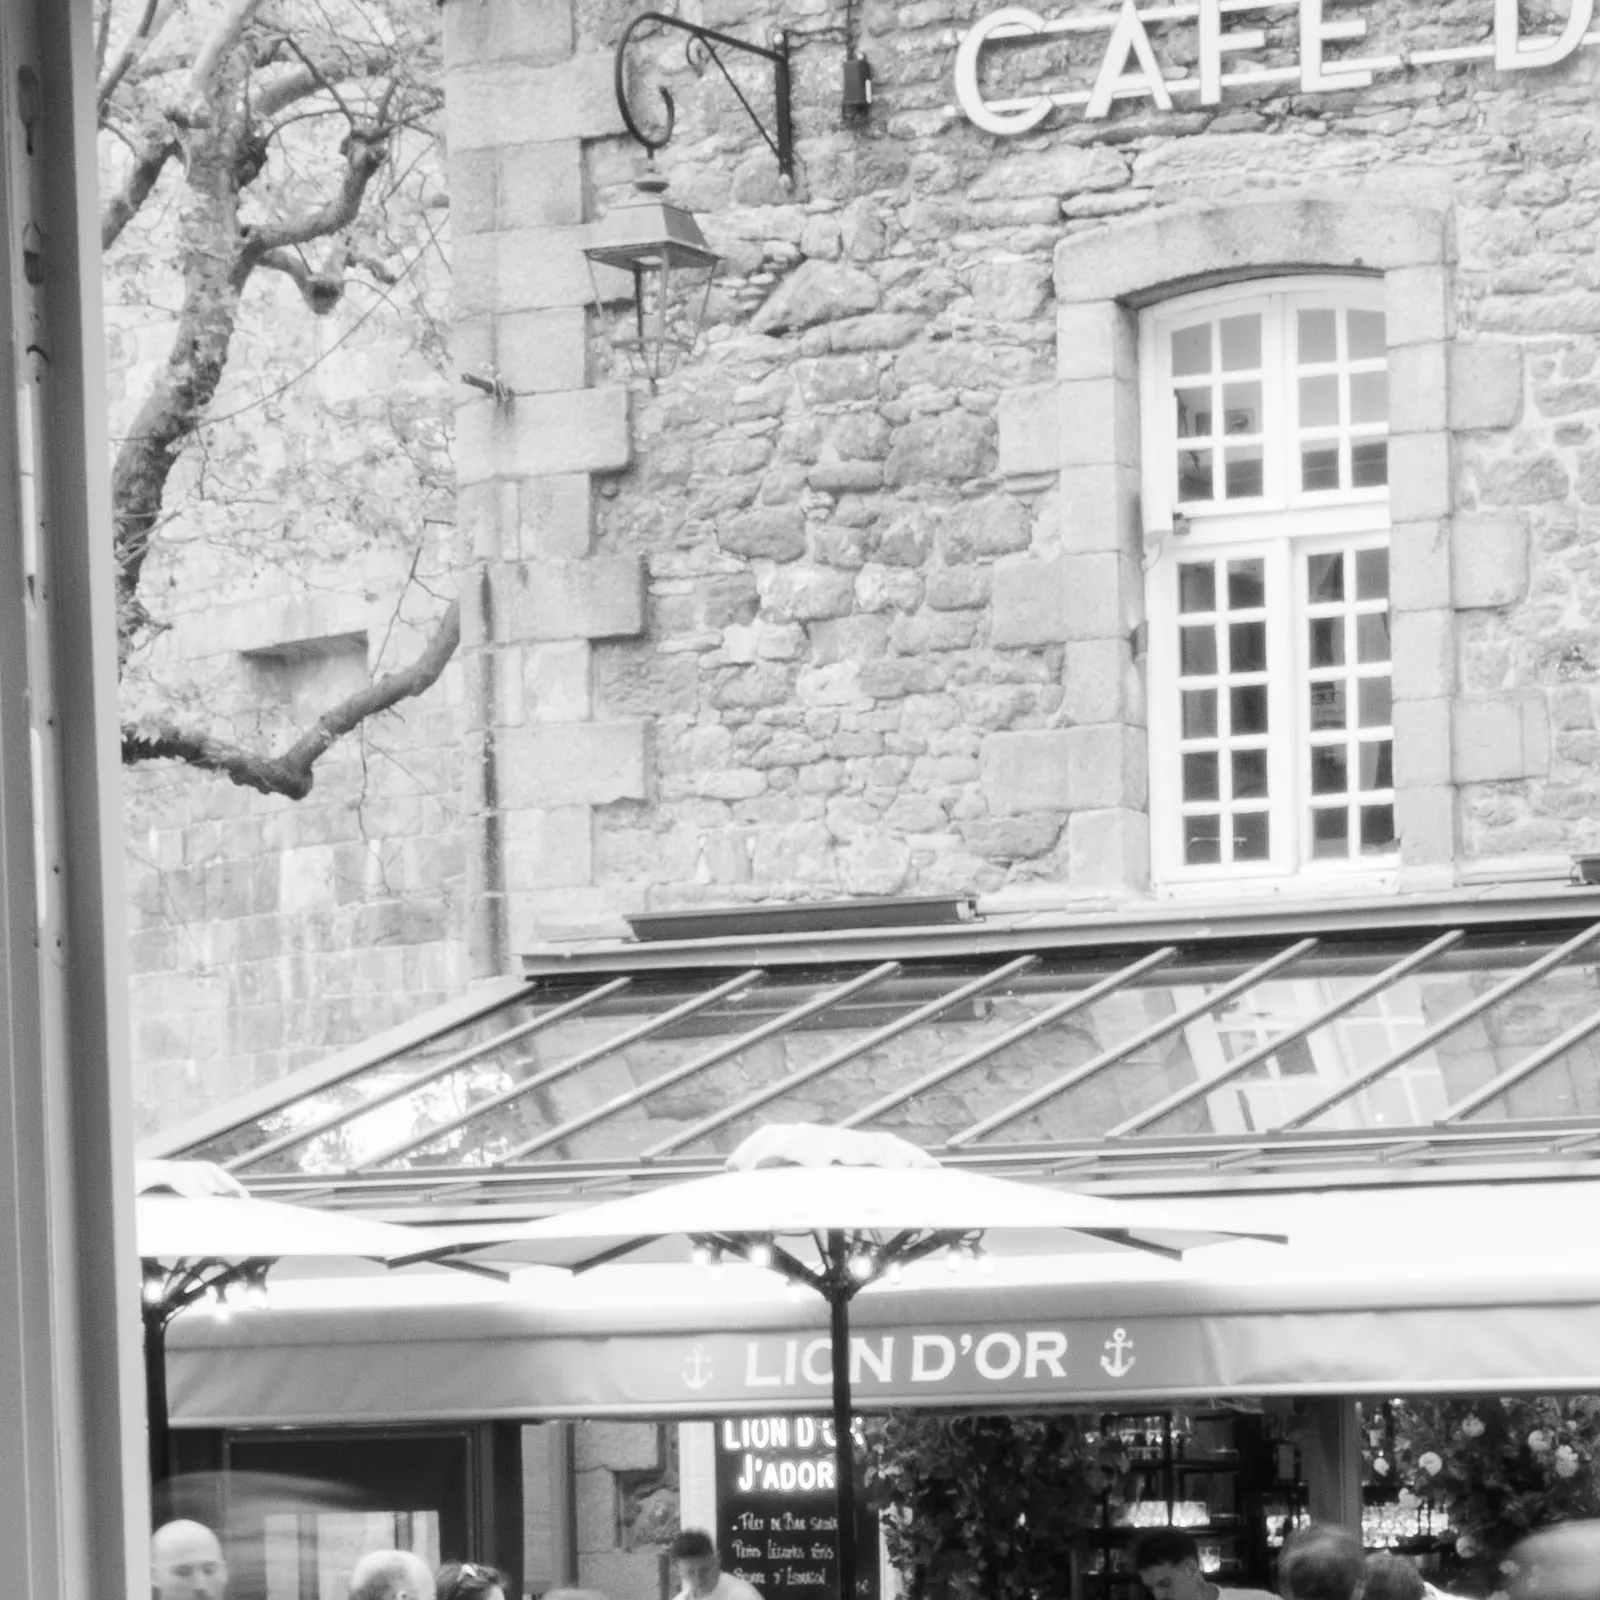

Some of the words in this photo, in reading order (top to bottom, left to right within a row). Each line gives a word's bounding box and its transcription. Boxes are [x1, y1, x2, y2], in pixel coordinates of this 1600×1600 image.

[745, 1336, 894, 1387] LION
[911, 1331, 1068, 1383] D'OR
[724, 1418, 789, 1451] LION
[738, 1453, 836, 1491] J'ADOR
